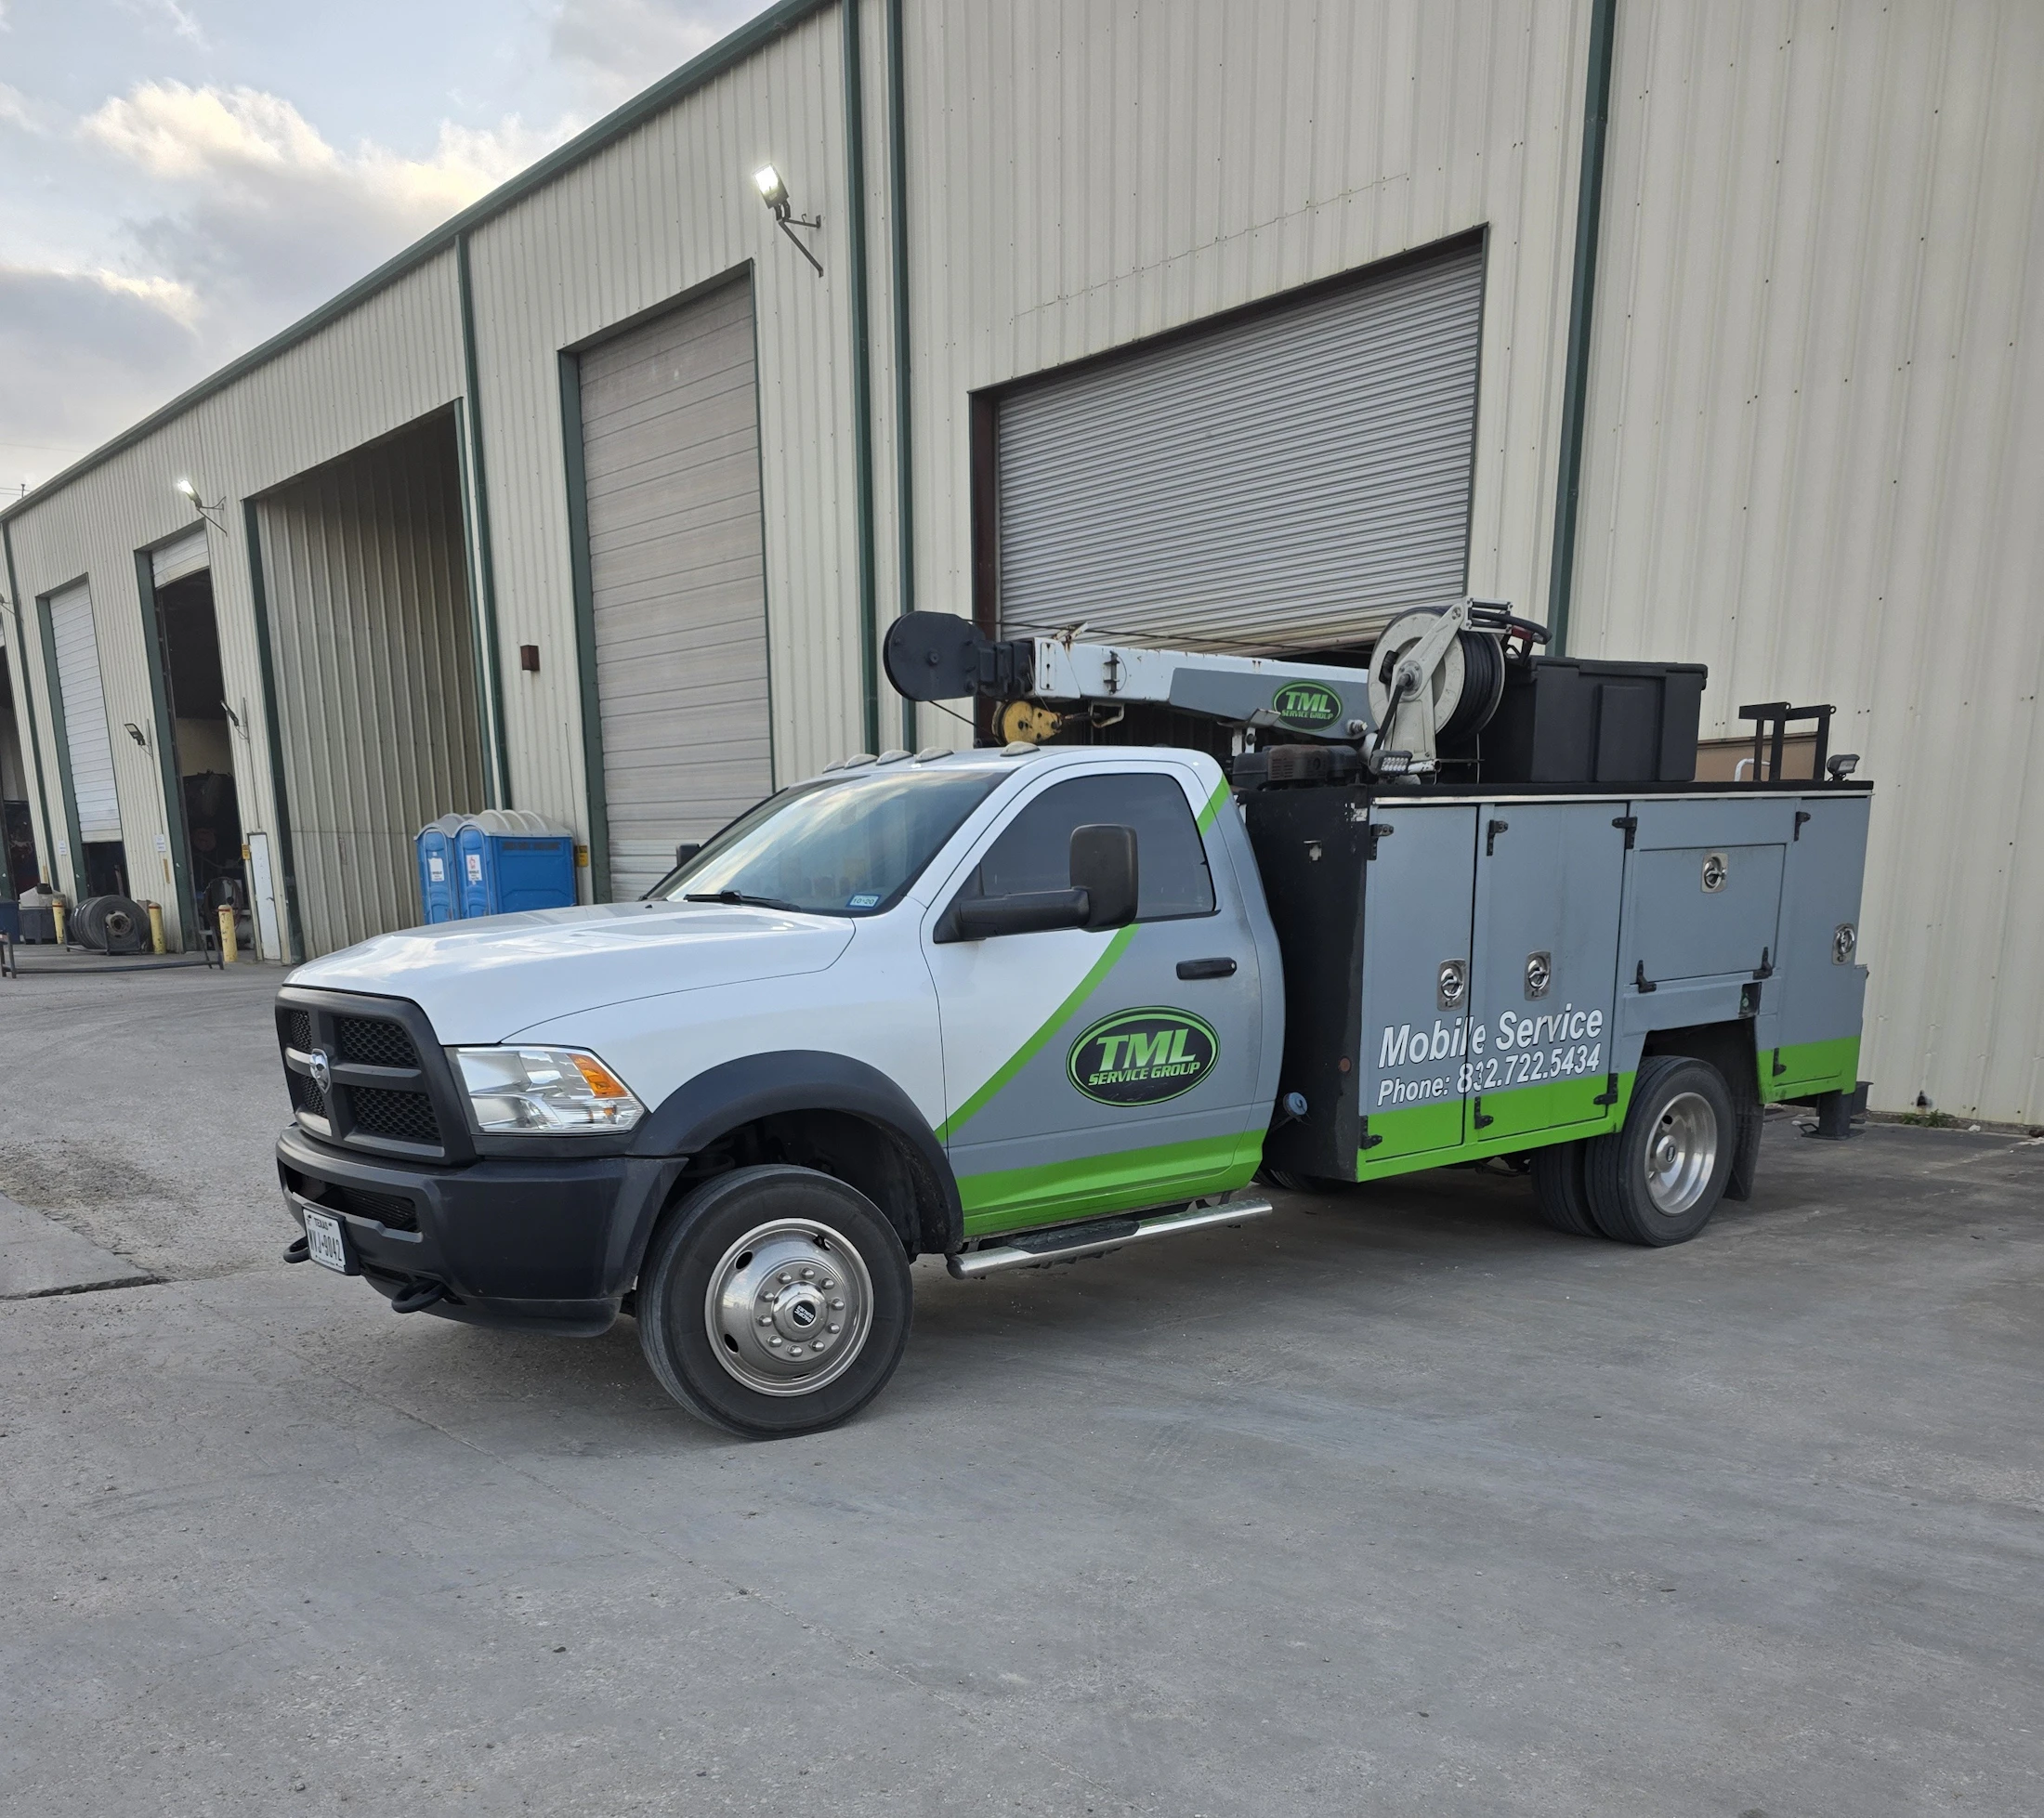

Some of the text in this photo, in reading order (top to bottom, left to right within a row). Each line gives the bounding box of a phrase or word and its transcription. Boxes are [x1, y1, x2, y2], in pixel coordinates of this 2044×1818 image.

[1285, 691, 1331, 713] TML
[1281, 710, 1334, 720] SERVICE GROUP
[1377, 1002, 1604, 1069] Mobile Service
[1096, 1028, 1197, 1072] TML
[1088, 1061, 1201, 1086] SERVICE GROUP
[1377, 1042, 1602, 1106] Phone: 832.722.5434
[314, 1217, 329, 1231] TEXAS
